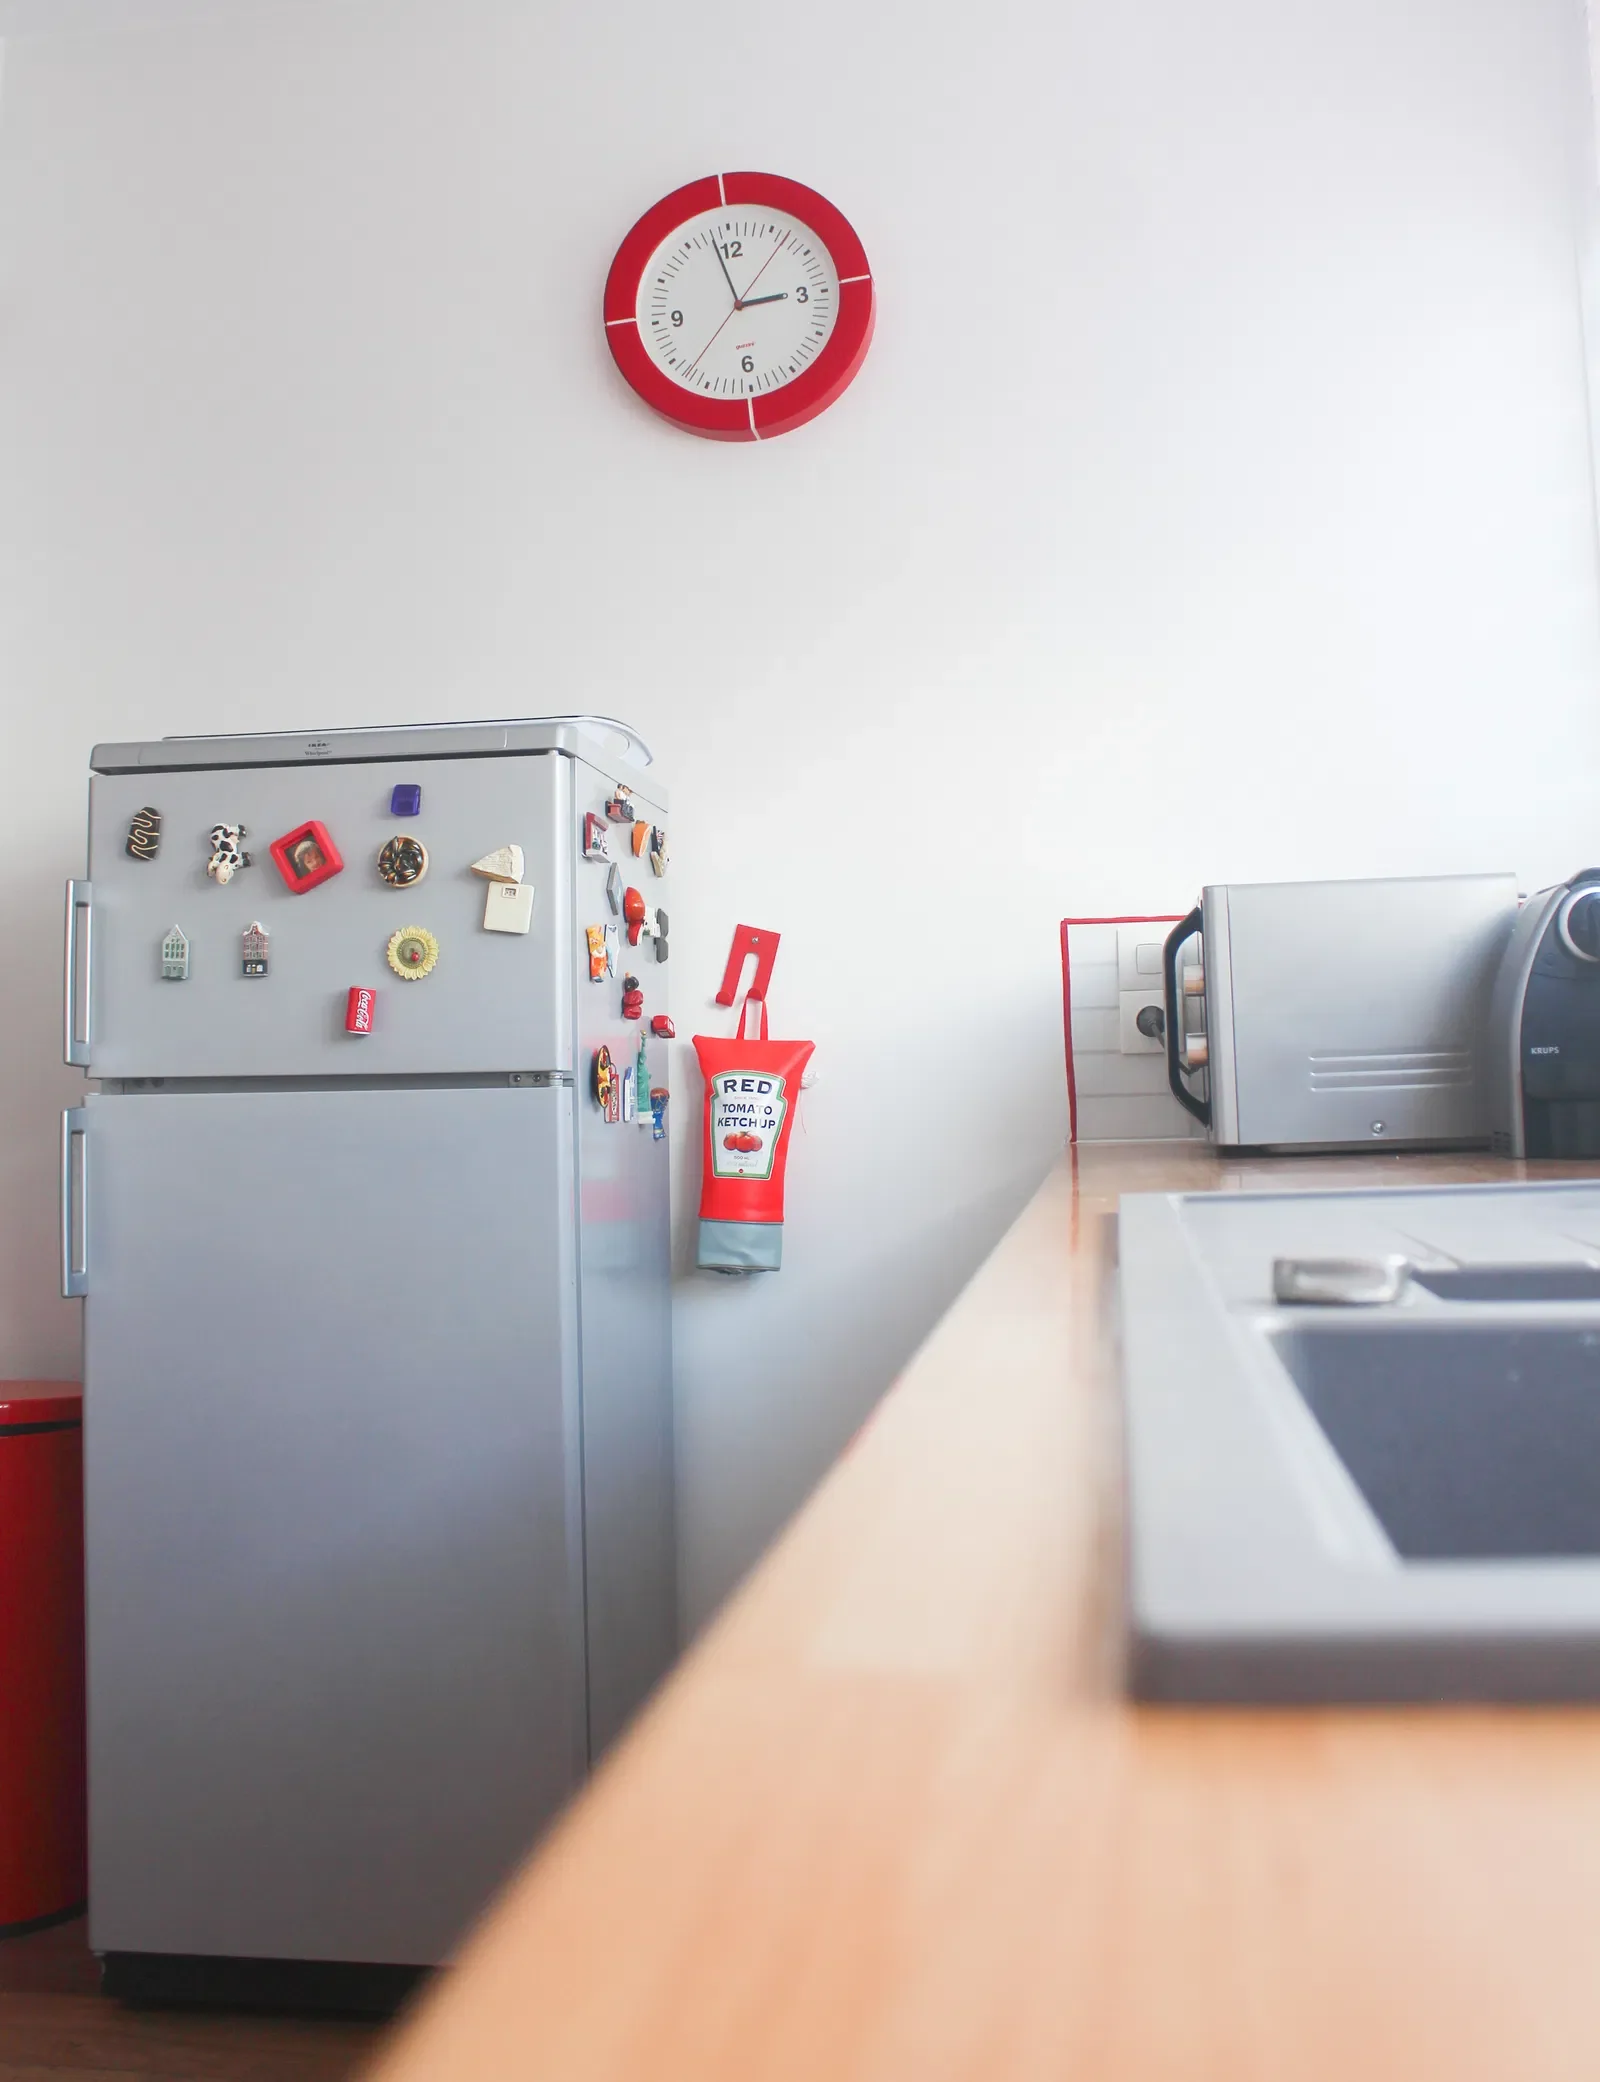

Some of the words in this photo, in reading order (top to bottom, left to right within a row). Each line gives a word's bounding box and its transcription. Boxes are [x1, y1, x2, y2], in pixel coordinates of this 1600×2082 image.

[720, 240, 744, 259] 12
[795, 286, 809, 304] 3
[670, 310, 684, 328] 9
[741, 355, 755, 373] 6
[1531, 1046, 1560, 1055] KRUPS
[723, 1078, 773, 1095] RED
[717, 1117, 776, 1129] KETCHUP
